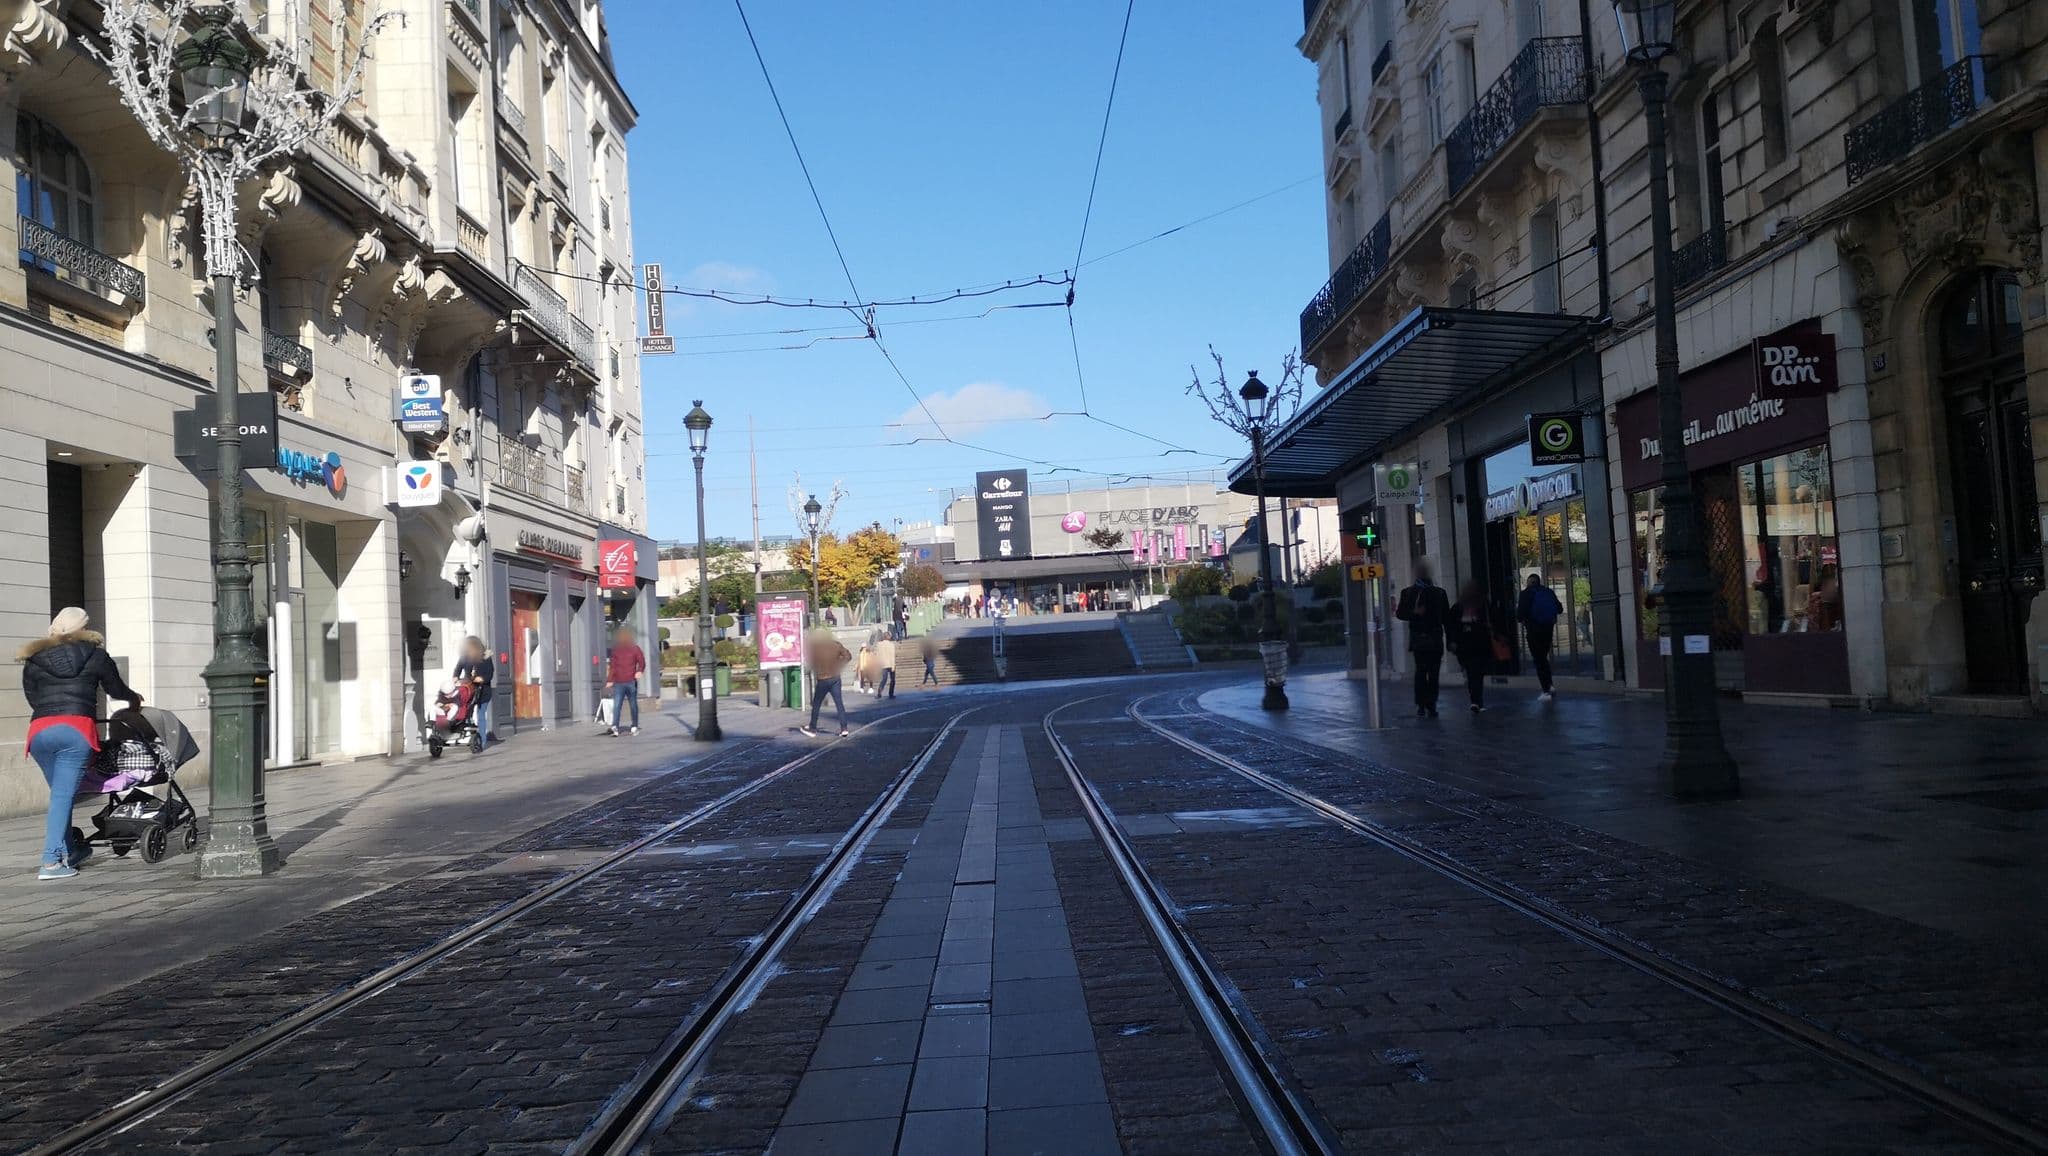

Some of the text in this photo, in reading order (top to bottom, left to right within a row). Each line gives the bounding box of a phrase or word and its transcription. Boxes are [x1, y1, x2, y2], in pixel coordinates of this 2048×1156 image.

[647, 266, 662, 330] HOTEL
[1771, 364, 1821, 386] am
[412, 402, 431, 410] Best
[201, 425, 268, 437] SEORA
[982, 491, 1024, 499] Carrefour
[994, 515, 1013, 523] ZARA
[1099, 509, 1149, 525] PLACE
[1152, 505, 1199, 523] D'ARC
[1357, 566, 1377, 579] 15
